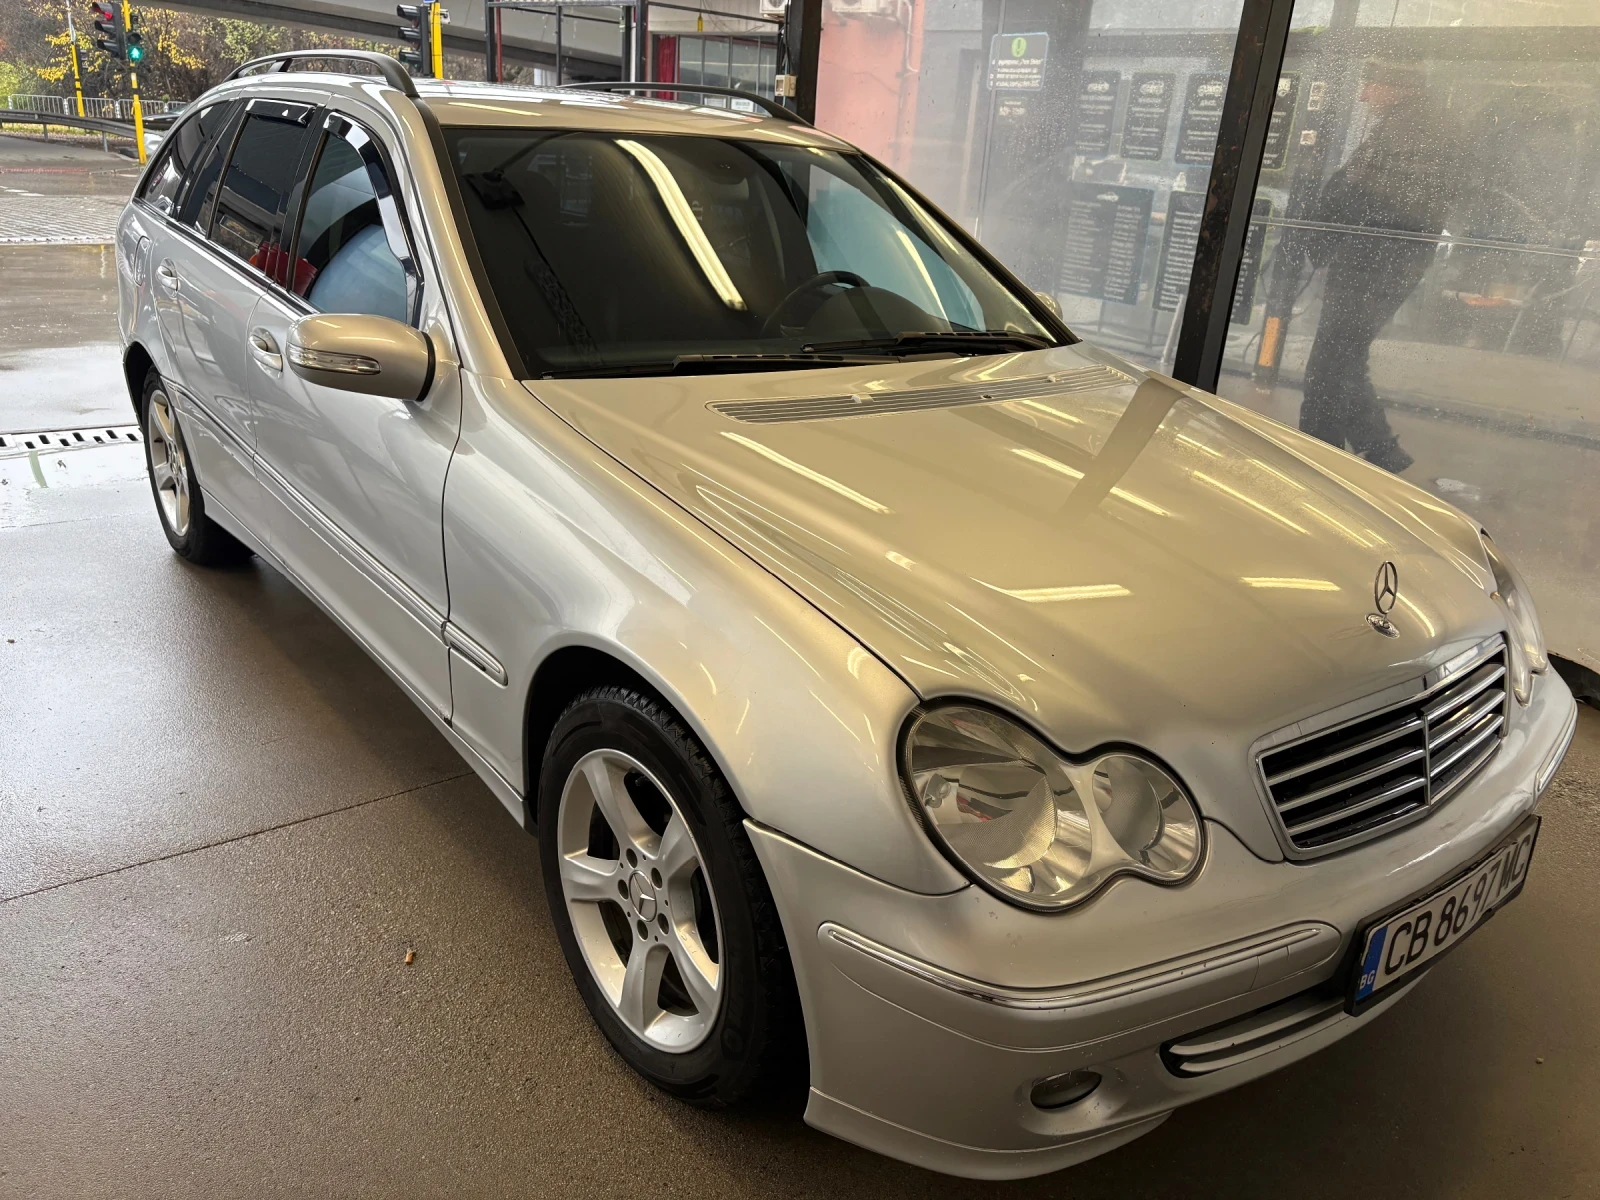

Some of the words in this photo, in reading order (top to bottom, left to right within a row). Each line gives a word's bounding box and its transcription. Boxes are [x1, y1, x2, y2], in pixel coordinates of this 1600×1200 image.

[1384, 910, 1433, 975] CB
[1434, 858, 1502, 947] 8697
[1359, 970, 1376, 990] BG
